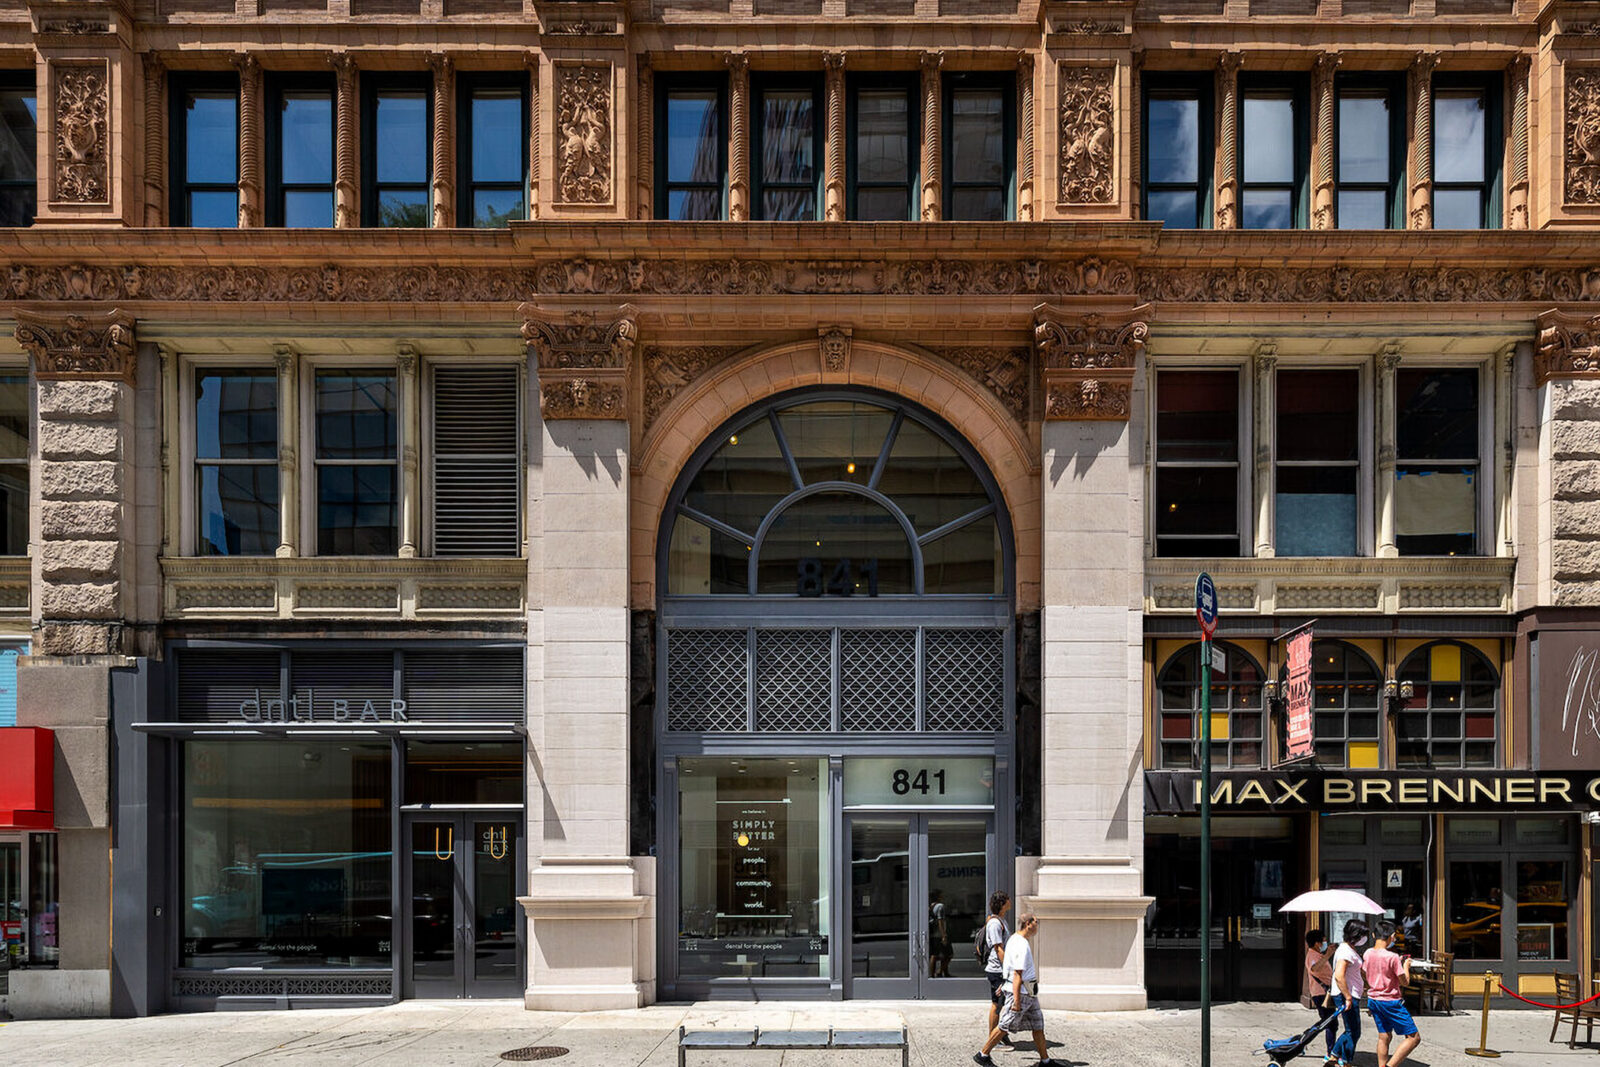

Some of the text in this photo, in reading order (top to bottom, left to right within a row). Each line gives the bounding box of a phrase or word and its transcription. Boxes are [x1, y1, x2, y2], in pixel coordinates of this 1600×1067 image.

[797, 557, 879, 597] 841
[333, 699, 407, 722] BAR
[892, 769, 946, 795] 841
[1193, 778, 1309, 804] MAX
[1323, 778, 1572, 804] BRENNER
[732, 820, 775, 829] SIMPLY
[1390, 871, 1399, 883] A
[762, 943, 783, 951] people
